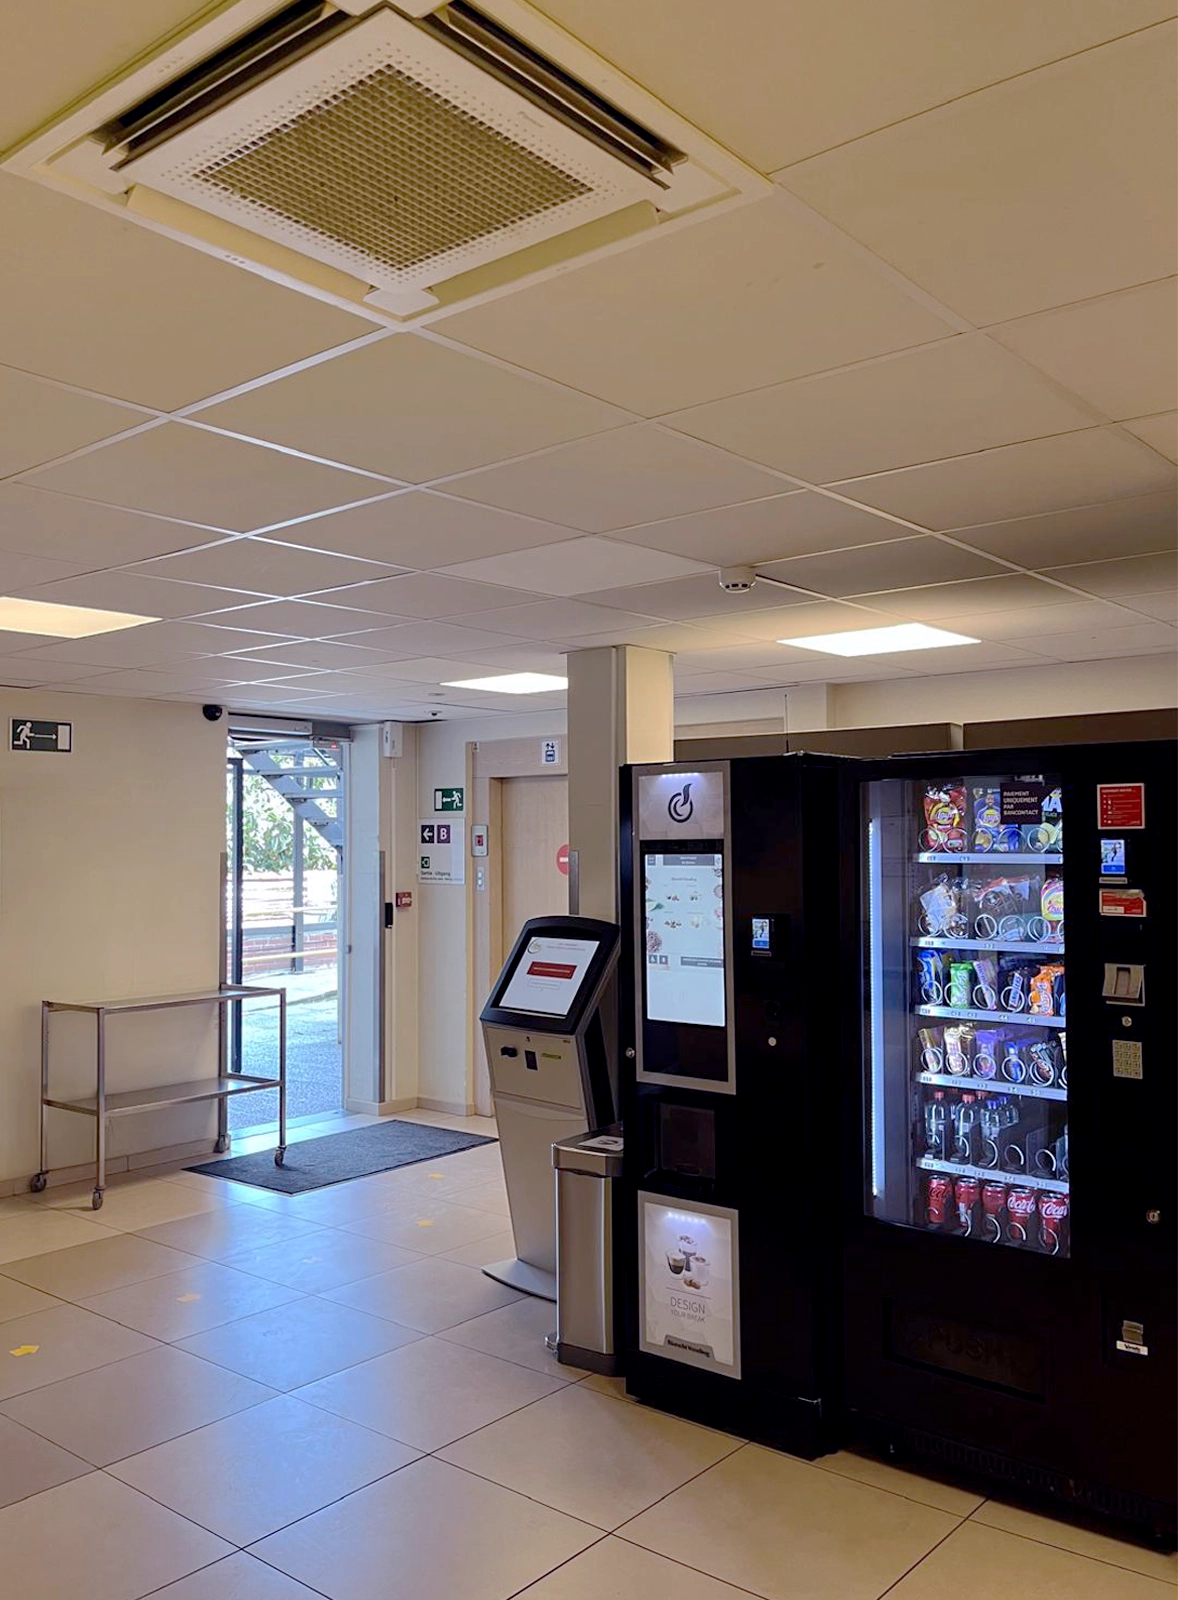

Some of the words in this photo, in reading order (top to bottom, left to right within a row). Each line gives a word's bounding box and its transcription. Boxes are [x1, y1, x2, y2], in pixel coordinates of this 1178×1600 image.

[440, 827, 447, 840] B
[670, 1296, 705, 1315] DESIGN
[671, 1309, 686, 1318] YOUR
[686, 1313, 706, 1324] BREAK
